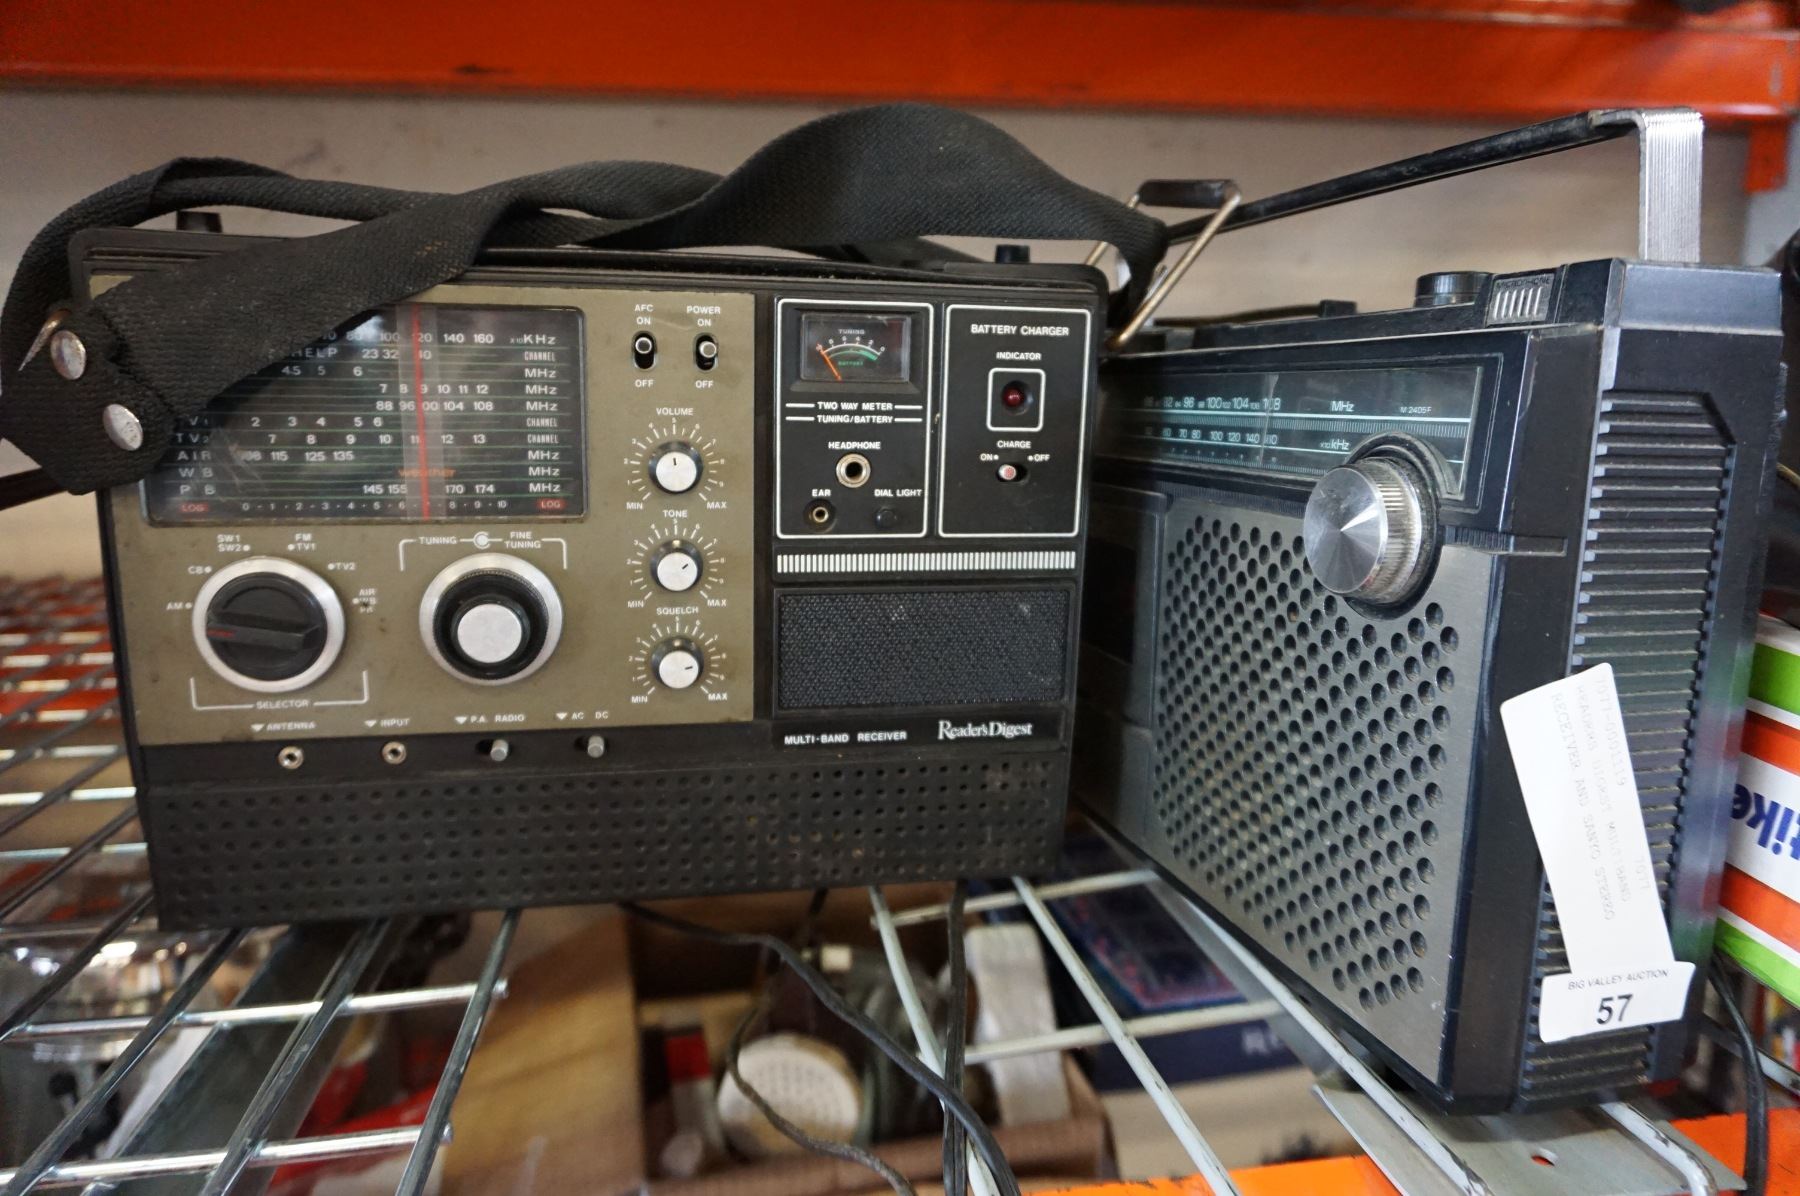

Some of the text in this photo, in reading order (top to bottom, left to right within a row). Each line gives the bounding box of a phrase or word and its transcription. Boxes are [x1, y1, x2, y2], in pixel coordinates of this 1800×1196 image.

[634, 304, 654, 312] AFC
[687, 306, 720, 314] POWER
[636, 317, 651, 325] ON
[697, 319, 712, 327] ON
[971, 324, 1069, 336] BATTERY CHARGER
[380, 332, 400, 341] 100
[443, 333, 464, 343] 140
[474, 333, 494, 343] 160
[361, 349, 379, 359] 23
[382, 349, 399, 359] 32
[524, 351, 556, 362] CHANNEL
[996, 352, 1041, 360] INDICATOR
[317, 365, 326, 376] 5
[353, 366, 363, 377] 6
[524, 368, 557, 378] MHz
[635, 380, 654, 388] OFF
[695, 380, 714, 389] OFF
[379, 384, 557, 394] 7 8 9 10 11 12 MHz
[376, 401, 558, 411] 88 96 00 104 108 MHz
[817, 402, 893, 411] TWO WAY METER
[1206, 397, 1222, 409] 100
[1232, 398, 1248, 409] 104
[1330, 401, 1354, 411] MHz
[656, 408, 694, 416] VOLUME
[251, 417, 260, 427] 2
[288, 417, 297, 427] 3
[316, 417, 326, 427] 4
[354, 417, 363, 427] 5
[373, 417, 383, 427] 6
[817, 415, 893, 424] TUNING/BATTERY
[268, 434, 277, 443] 7
[306, 434, 316, 444] 8
[346, 434, 356, 444] 9
[379, 434, 392, 444] 10
[410, 434, 420, 444] 11
[441, 434, 454, 444] 12
[473, 434, 486, 444] 13
[1210, 431, 1223, 440] 100
[1228, 432, 1240, 442] 120
[1246, 433, 1259, 443] 140
[828, 441, 881, 450] HEADPHONE
[997, 440, 1031, 449] CHARGE
[271, 451, 289, 461] 115
[305, 451, 326, 461] 125
[333, 451, 354, 461] 135
[527, 451, 560, 460] MHz
[980, 453, 993, 461] ON
[528, 467, 560, 476] MHz
[363, 485, 384, 494] 145
[388, 485, 408, 494] 155
[445, 484, 465, 494] 170
[475, 484, 495, 494] 174
[529, 483, 561, 492] MHz
[812, 489, 831, 497] EAR
[874, 489, 922, 497] DIAL LIGHT
[296, 503, 303, 511] 2
[321, 503, 329, 511] 3
[347, 502, 355, 510] 4
[626, 502, 643, 510] MIN
[706, 502, 727, 510] MAX
[663, 510, 688, 518] TONE
[217, 535, 241, 543] SW1
[510, 531, 532, 540] FINE
[419, 536, 457, 545] TUNING
[504, 541, 542, 549] TUNING
[218, 544, 241, 552] SW2
[167, 602, 184, 610] AM
[656, 607, 699, 616] SQUELCH
[256, 700, 309, 709] SELECTOR
[494, 713, 525, 722] RADIO
[571, 711, 608, 720] AC DC
[266, 721, 316, 731] ANTENNA
[381, 718, 410, 727] INPUT
[1551, 692, 1581, 770] RECEIVER
[857, 731, 907, 742] RECEIVER
[1568, 969, 1668, 990] BIG VALLEY AUCTION
[1597, 994, 1633, 1024] 57
